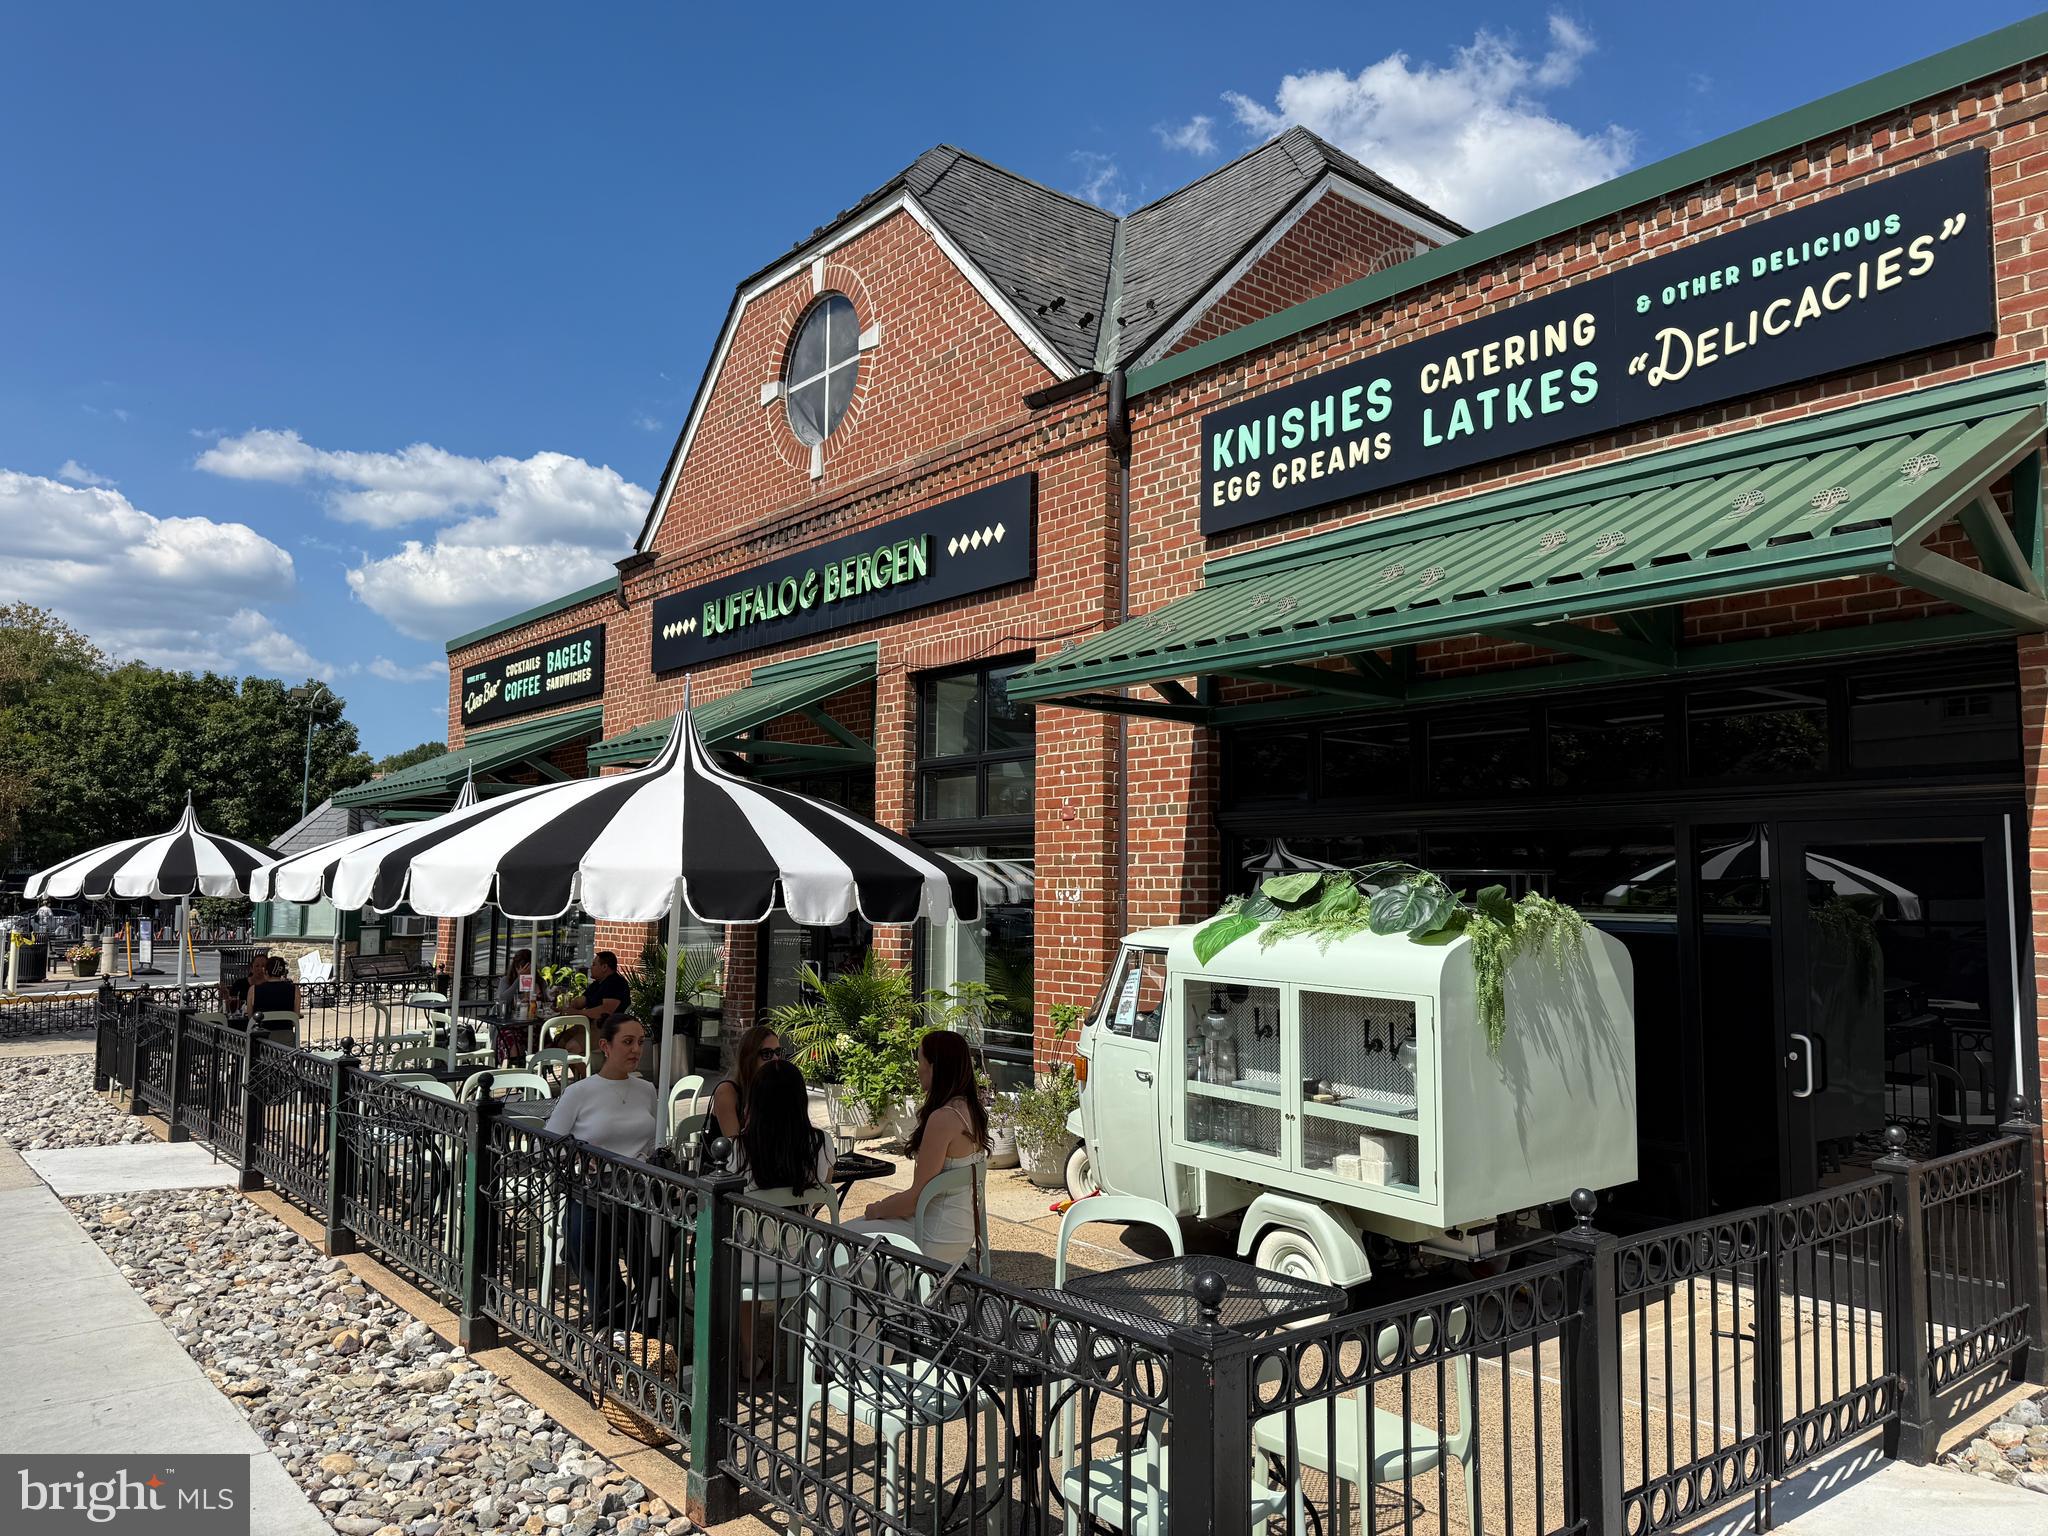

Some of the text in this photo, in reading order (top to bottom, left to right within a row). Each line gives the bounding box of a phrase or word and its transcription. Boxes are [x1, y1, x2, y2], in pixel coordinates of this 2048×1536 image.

[1635, 213, 1902, 314] & OTHER DELICIOUS
[1420, 312, 1597, 395] CATERING
[1212, 377, 1394, 472] KNISHES
[1423, 360, 1599, 447] LATKES
[1212, 432, 1392, 507] EGG CREAMS
[702, 533, 930, 637] BUFFALO & BERGEN
[504, 674, 542, 702] COFFEE
[505, 656, 541, 677] COCKTAILS
[545, 667, 592, 692] SANDWICHES
[546, 639, 592, 674] BAGELS
